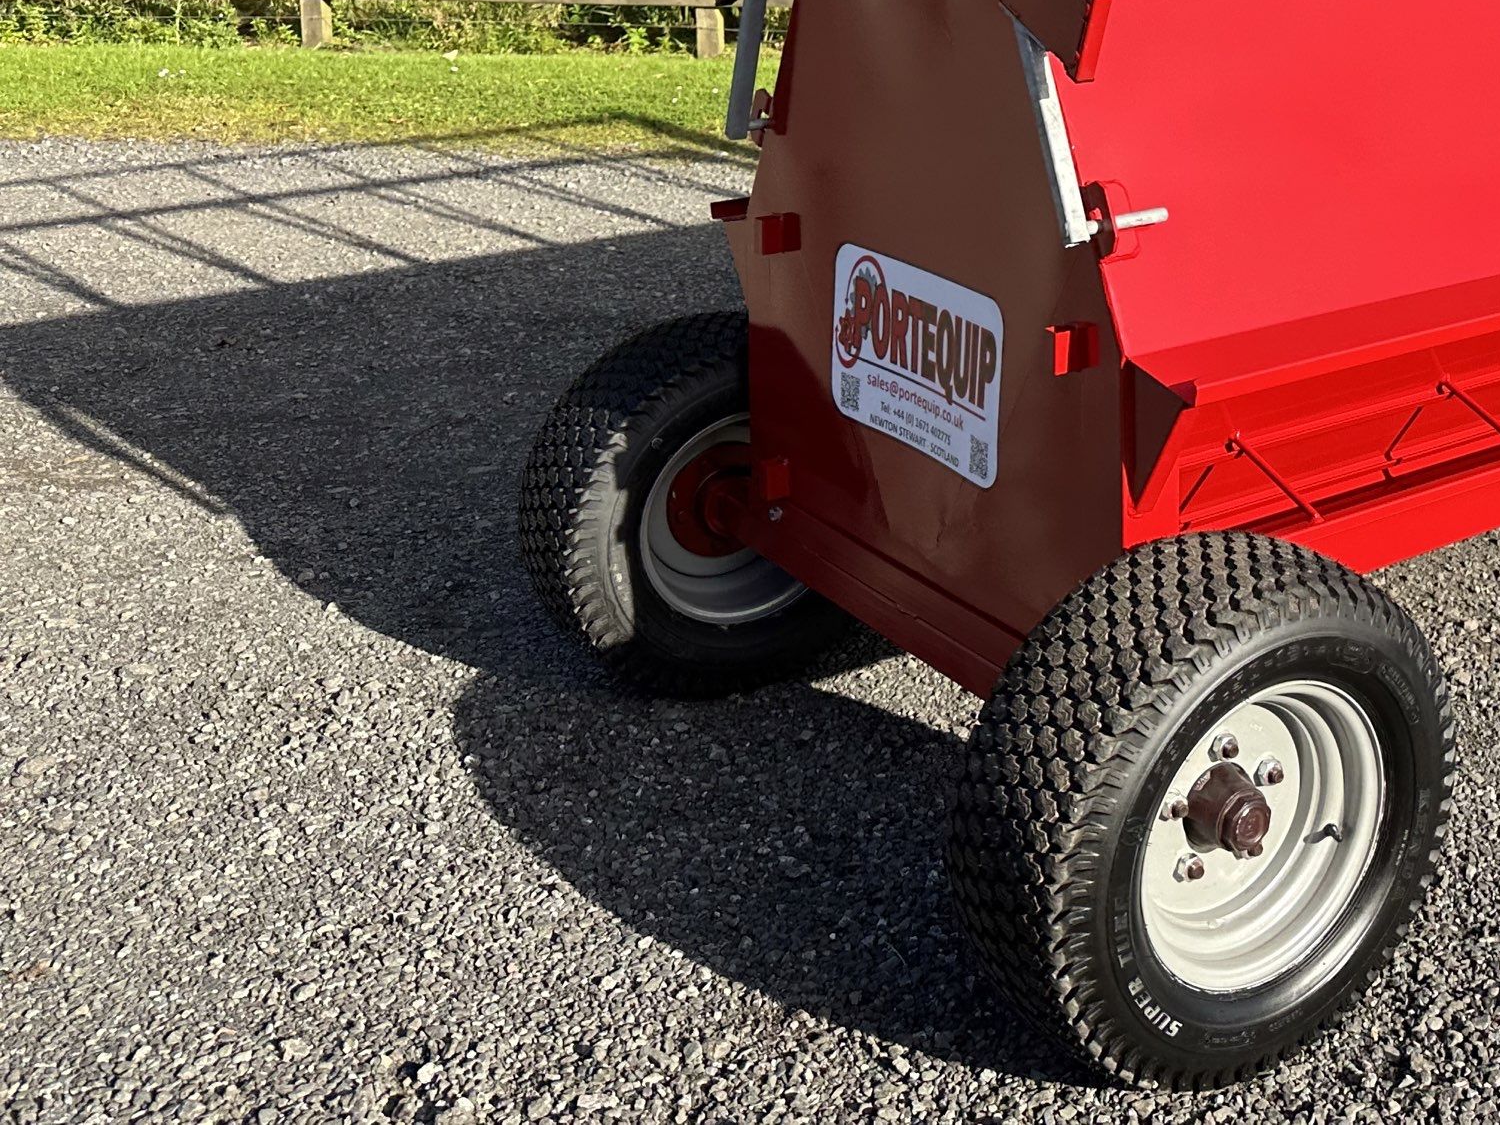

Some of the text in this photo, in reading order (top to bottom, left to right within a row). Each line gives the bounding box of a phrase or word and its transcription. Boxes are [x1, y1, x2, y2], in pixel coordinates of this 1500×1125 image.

[854, 276, 997, 410] PORTEQUIP
[867, 374, 964, 431] sales@portequip.co.uk
[893, 408, 905, 421] +44
[905, 411, 915, 427] (0)
[915, 417, 929, 433] 1671
[869, 413, 960, 468] NEWTON STEWART SCOTLAND
[1126, 976, 1183, 1038] SUPER
